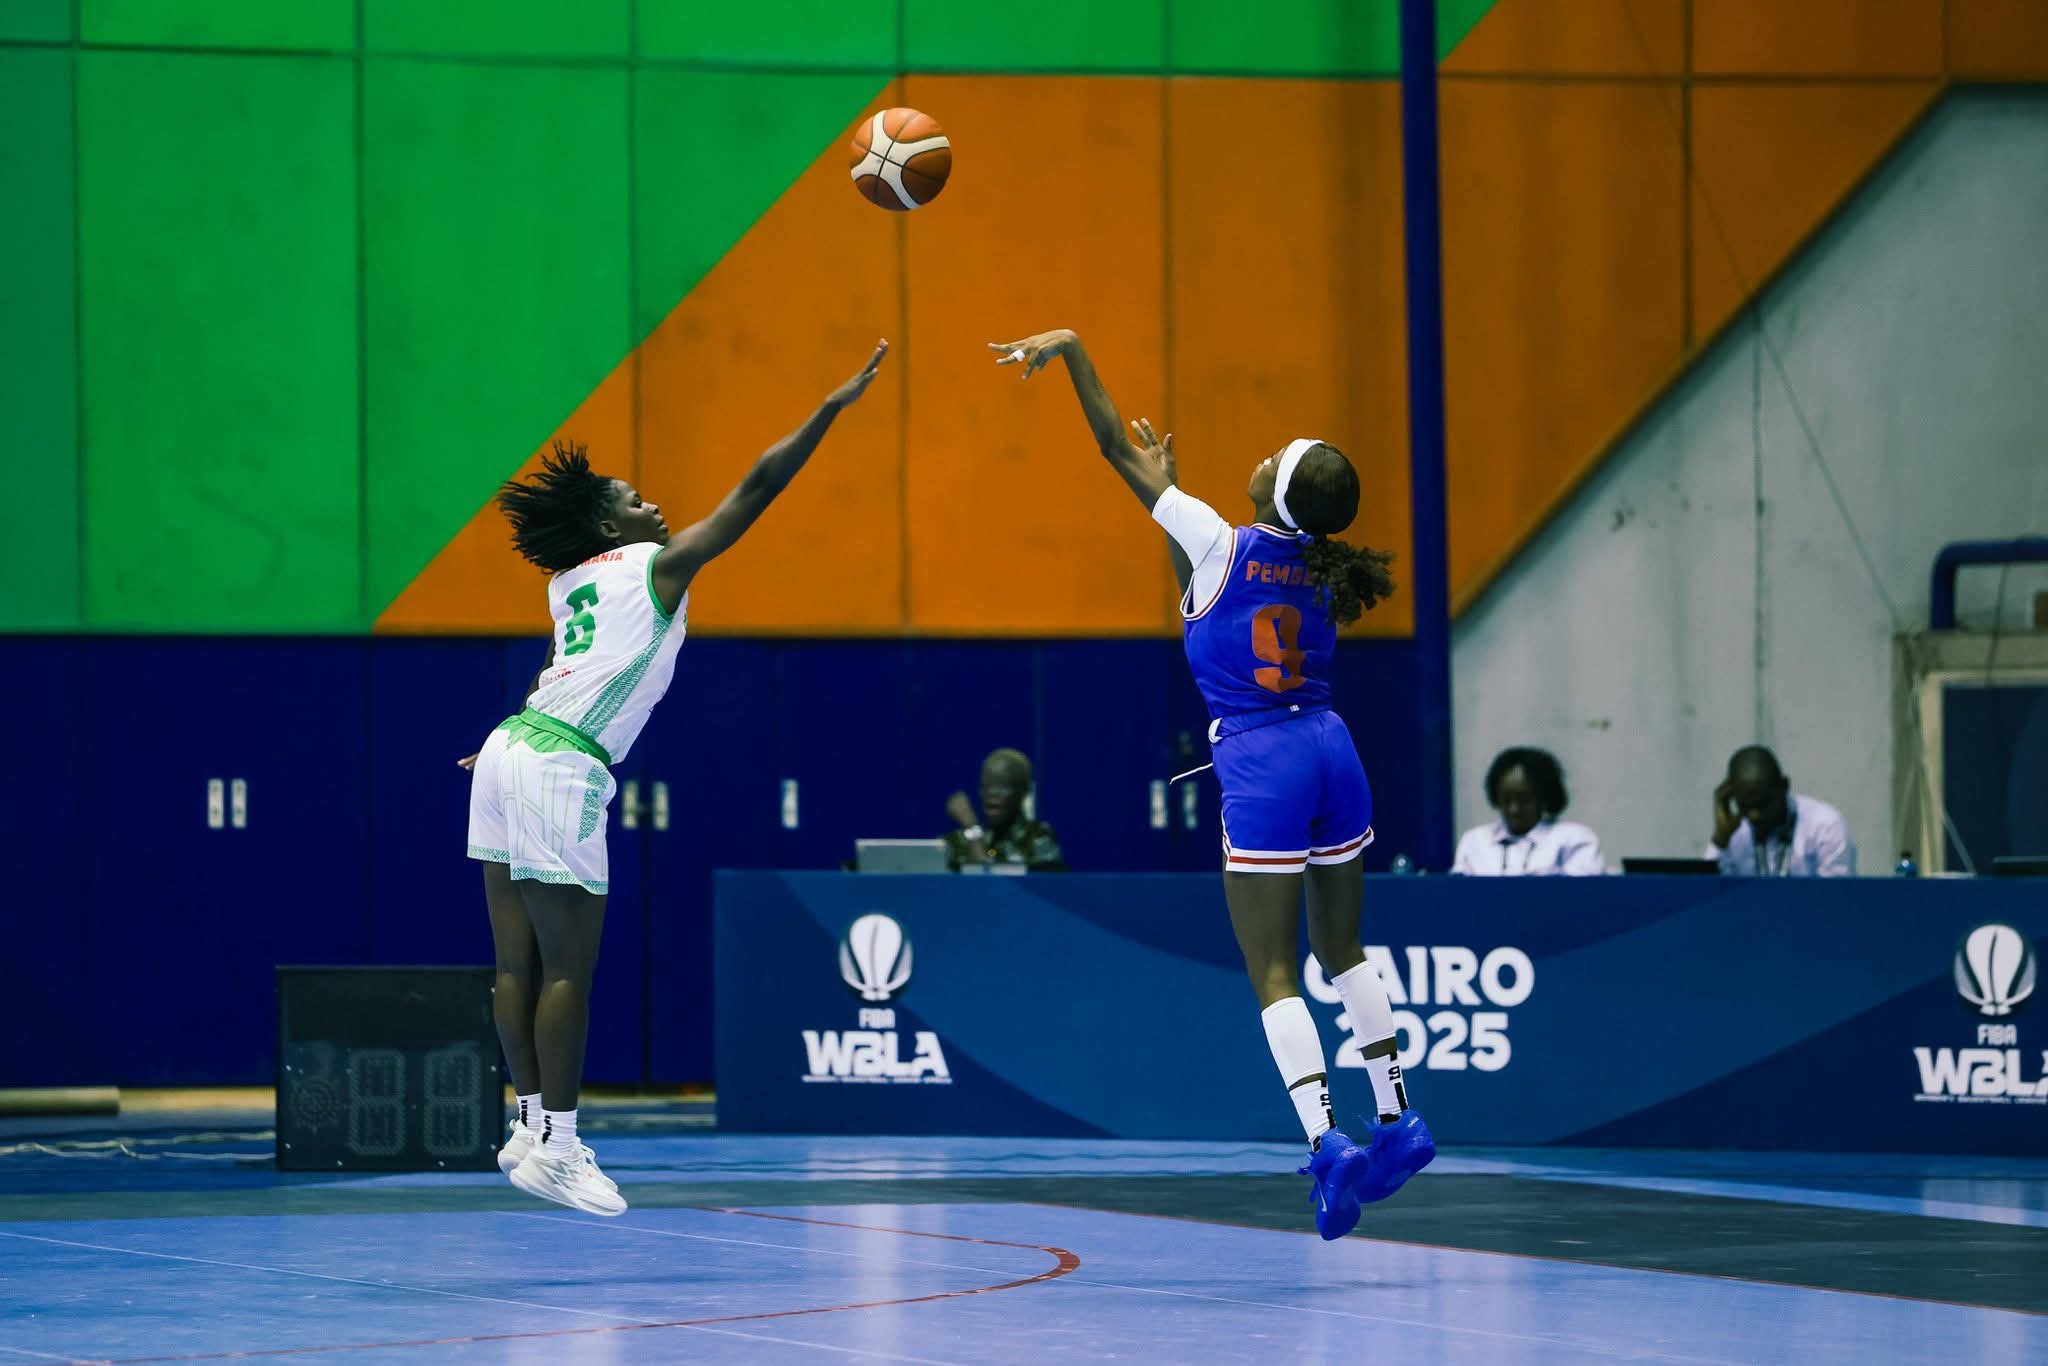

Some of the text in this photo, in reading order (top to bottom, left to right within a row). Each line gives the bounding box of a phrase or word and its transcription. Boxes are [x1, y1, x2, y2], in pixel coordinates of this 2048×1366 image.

[564, 582, 599, 656] 6
[1252, 604, 1306, 693] 9
[802, 1030, 950, 1077] WBLA
